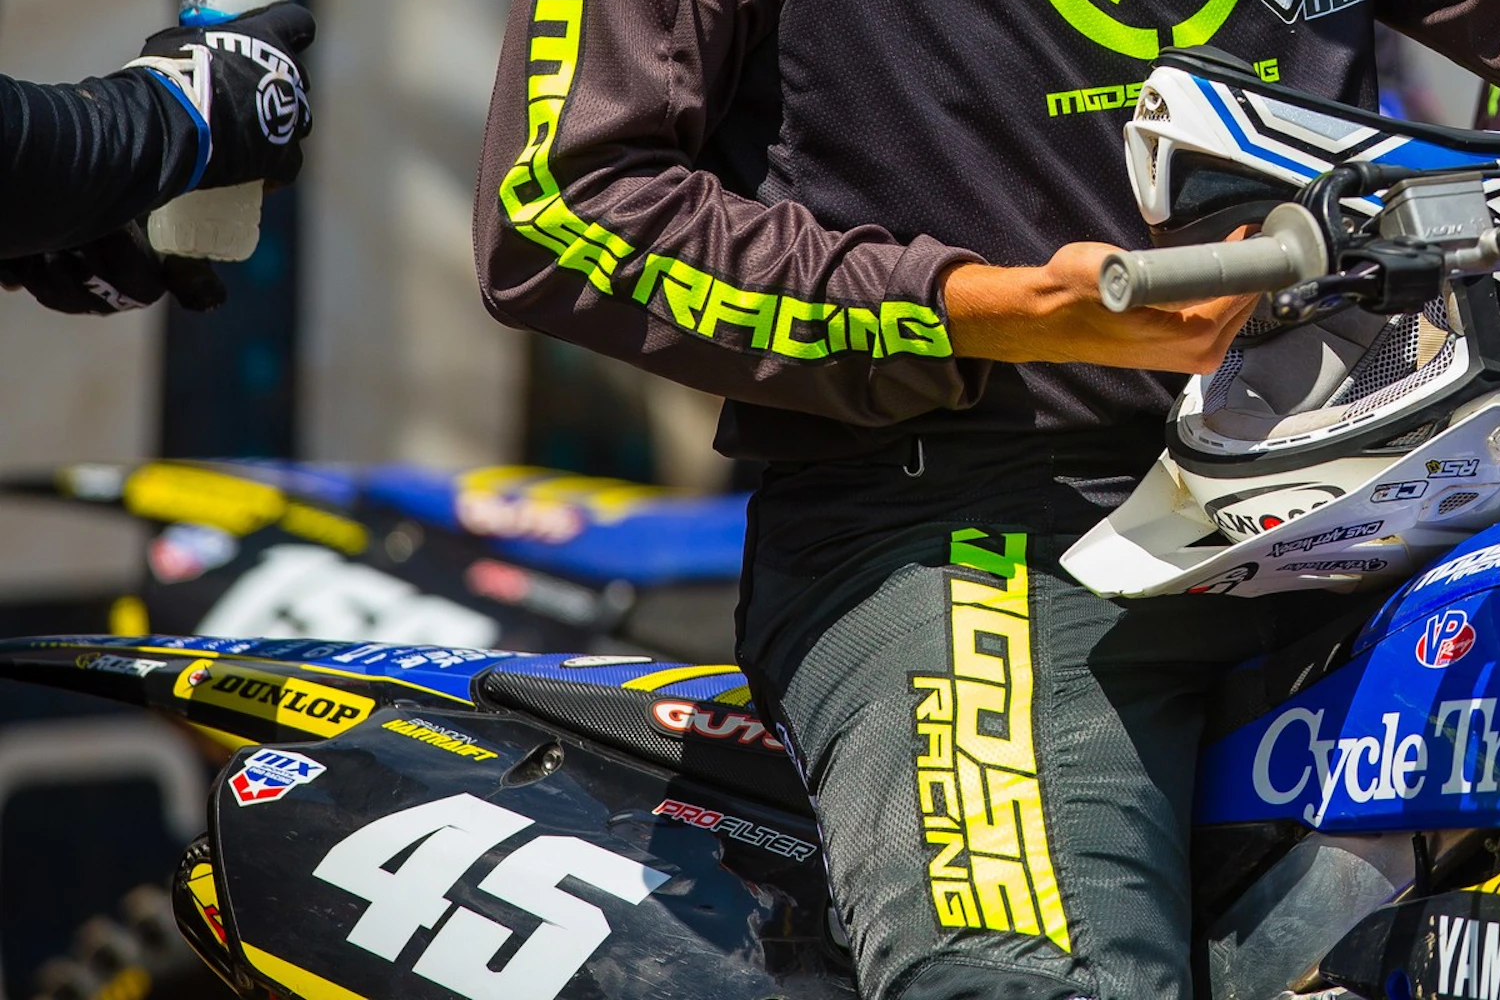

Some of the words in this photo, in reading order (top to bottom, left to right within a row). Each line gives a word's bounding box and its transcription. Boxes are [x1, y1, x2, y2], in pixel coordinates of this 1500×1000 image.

[632, 252, 953, 359] RACING
[1425, 610, 1468, 666] VP
[212, 674, 361, 725] DUNLOP
[407, 717, 479, 745] BRANDON
[249, 765, 265, 776] PRO
[253, 752, 320, 777] MX
[949, 527, 1071, 955] MOOSE
[1252, 707, 1425, 828] Cycle
[912, 676, 982, 930] RACING
[312, 792, 671, 1000] 45
